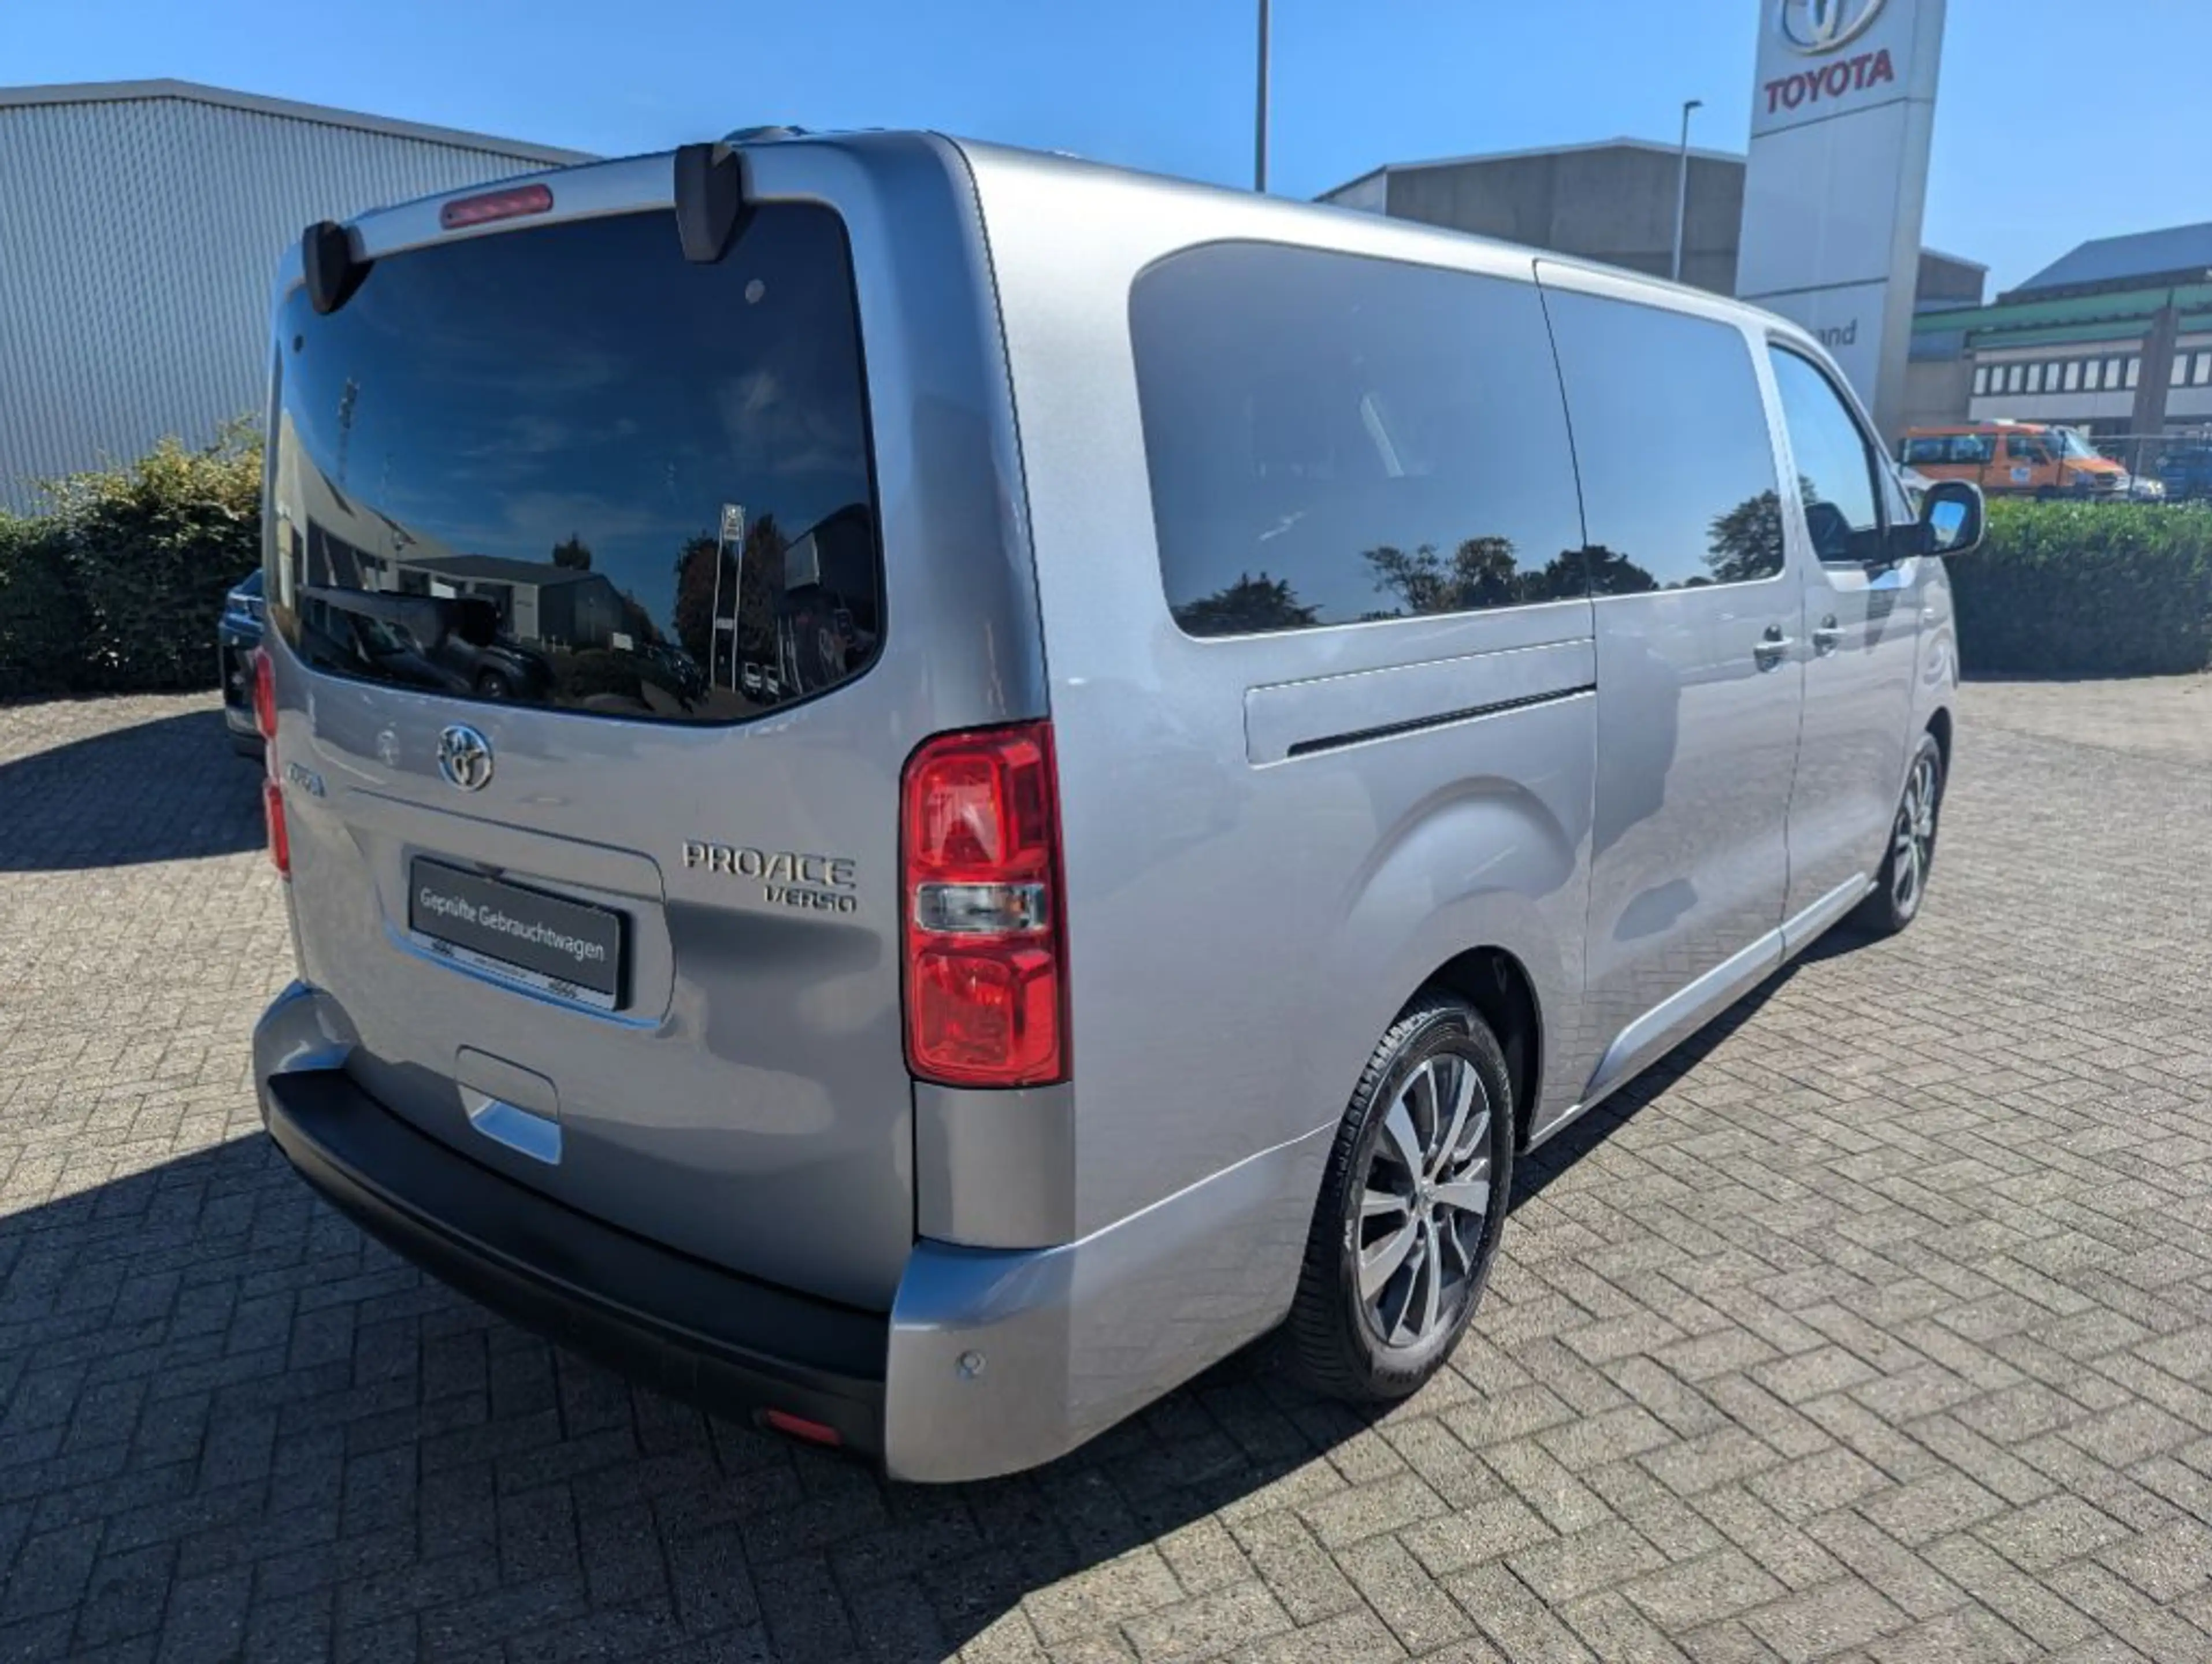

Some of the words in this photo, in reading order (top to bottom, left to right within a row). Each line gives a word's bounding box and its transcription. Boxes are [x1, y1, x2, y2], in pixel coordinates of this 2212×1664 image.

[1764, 48, 1893, 114] TOYOTA
[1812, 317, 1857, 347] and
[682, 840, 856, 889] PROACE
[764, 885, 856, 913] VERSO
[420, 887, 477, 923] Geprüfte
[479, 905, 604, 961] Gebrauchtwagen
